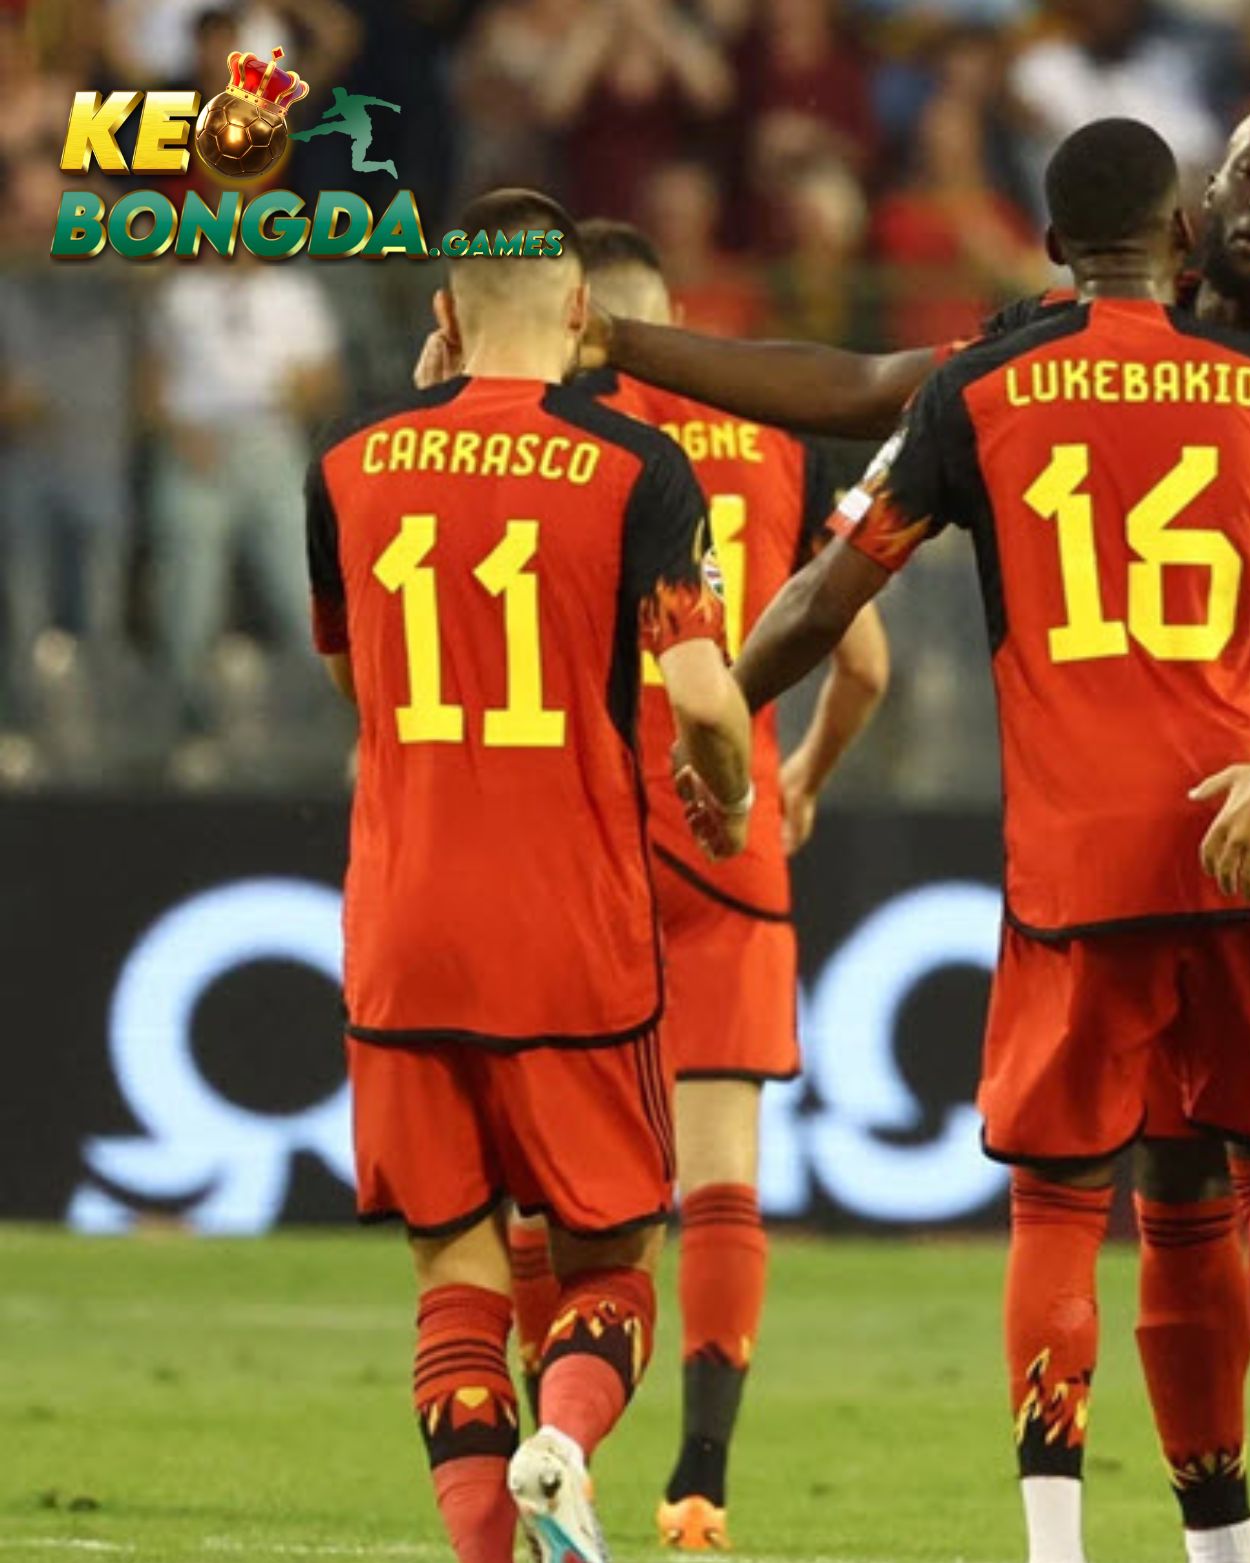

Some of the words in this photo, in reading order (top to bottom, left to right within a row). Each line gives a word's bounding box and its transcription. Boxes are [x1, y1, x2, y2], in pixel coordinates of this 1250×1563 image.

[362, 427, 601, 484] CARRASCO
[1022, 442, 1243, 663] 16
[372, 514, 567, 747] 11
